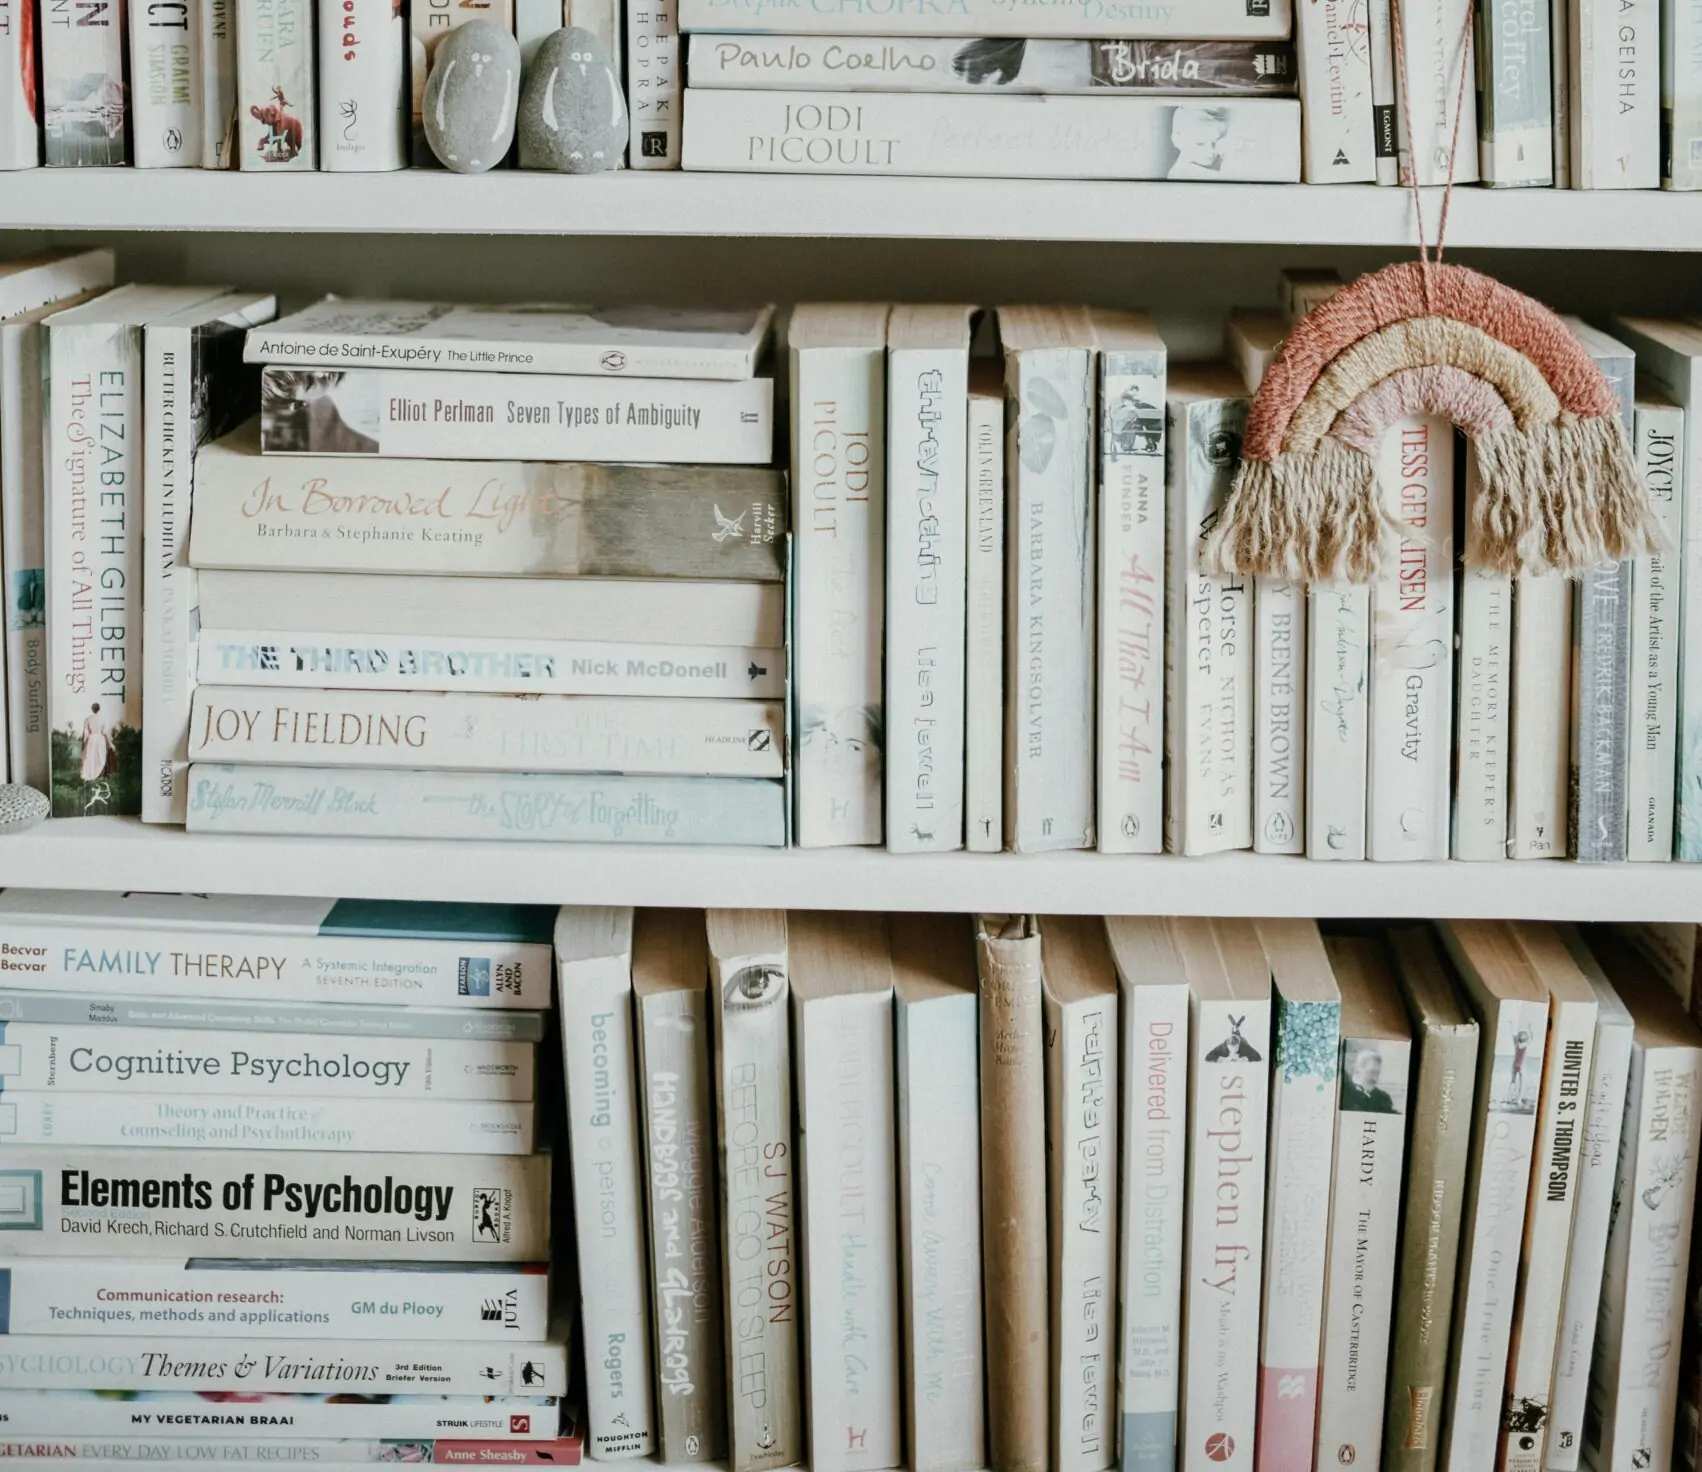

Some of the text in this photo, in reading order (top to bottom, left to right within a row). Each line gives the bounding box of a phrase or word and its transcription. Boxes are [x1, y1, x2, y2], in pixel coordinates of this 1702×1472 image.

[171, 44, 190, 106] GRAEME
[716, 42, 1200, 81] Paulo Coelho Brida
[1618, 27, 1635, 115] GEISHA
[784, 104, 862, 134] JODI
[1382, 110, 1391, 153] EGMONT
[748, 136, 900, 165] PICOULT
[260, 341, 533, 364] Antoine de Saint-Exupéry The Little Prince
[390, 399, 700, 429] Elliot Perlman Seven Types of Ambiguity
[162, 352, 175, 577] BUTTER CHICKEN LUDHIANA
[814, 402, 836, 538] PICOULT
[842, 432, 869, 501] JODI
[1401, 426, 1428, 477] TESS
[301, 477, 452, 519] Borrowed
[1121, 465, 1132, 533] FUNDER
[1137, 474, 1148, 524] ANNA
[65, 374, 96, 694] The Signature of All Things
[100, 371, 125, 703] ELIZABETH GILBERT
[257, 523, 483, 546] Barbara Stephanie Keating
[751, 503, 761, 544] Harvill
[764, 504, 778, 543] Secker
[1029, 503, 1043, 758] BARBARA KINGSOLVER
[217, 645, 726, 679] THE THIRD BROTHER Nick McDonell
[1271, 613, 1294, 696] BRENÉ
[25, 639, 43, 734] Body Surfing
[1646, 616, 1664, 750] Artist Young Man
[200, 705, 427, 750] JOY FIELDING
[1401, 676, 1423, 762] Gravity
[1469, 657, 1482, 760] DAUGHTER
[1484, 591, 1500, 825] THE MEMORY KEEPER'S
[1595, 624, 1615, 793] FREDRIK BACKMAN
[1270, 703, 1290, 800] BROWN
[160, 760, 172, 797] PICADOR
[1, 943, 47, 956] Becvar
[1, 960, 47, 972] Becvar
[64, 949, 438, 980] FAMILY THERAPY A Systemic Integration
[316, 976, 423, 989] SEVENTH EDITION
[459, 960, 467, 993] PEARSON
[496, 964, 504, 992] ALLYN
[514, 963, 522, 995] BACON
[48, 1036, 58, 1086] Sternberg
[70, 1048, 410, 1086] Cognitive Psychology
[590, 1012, 616, 1127] becoming
[1147, 1022, 1173, 1120] Delivered
[157, 1104, 308, 1120] Theory and Practice
[1547, 1041, 1583, 1201] HUNTER S. THOMPSON
[1649, 1069, 1672, 1143] HOLDEN
[121, 1125, 354, 1144] Counseling and Psychotherapy
[1146, 1130, 1170, 1176] from
[1207, 1076, 1252, 1227] stephen
[1360, 1120, 1376, 1186] HARDY
[61, 1170, 454, 1221] Elements of Psychology
[591, 1162, 617, 1238] person
[62, 1218, 454, 1241] David Krech, Richard S. Crutchfield and Norman Livson
[731, 1063, 766, 1409] BEFORE GO SLEEP
[1144, 1186, 1169, 1297] Distraction
[765, 1192, 791, 1324] WATSON
[1202, 1245, 1249, 1295] fry
[50, 1306, 330, 1324] Techniques, methods and applications
[97, 1289, 284, 1304] Communication research:
[351, 1302, 444, 1317] GM du Plooy
[505, 1289, 520, 1330] JUTA
[141, 1353, 379, 1380] Themes & Variations
[413, 1364, 442, 1372] Edition
[605, 1333, 625, 1398] Rogers
[1213, 1373, 1230, 1421] Washpot
[132, 1415, 293, 1425] MY VEGETARIAN BRAAI
[470, 1420, 503, 1428] LIFESTYLE
[597, 1431, 648, 1442] HOUGHTON
[83, 1444, 249, 1460] EVERY DAY LOW FAT
[446, 1450, 526, 1462] Anne Sheasby
[605, 1444, 641, 1453] MIFFLIN
